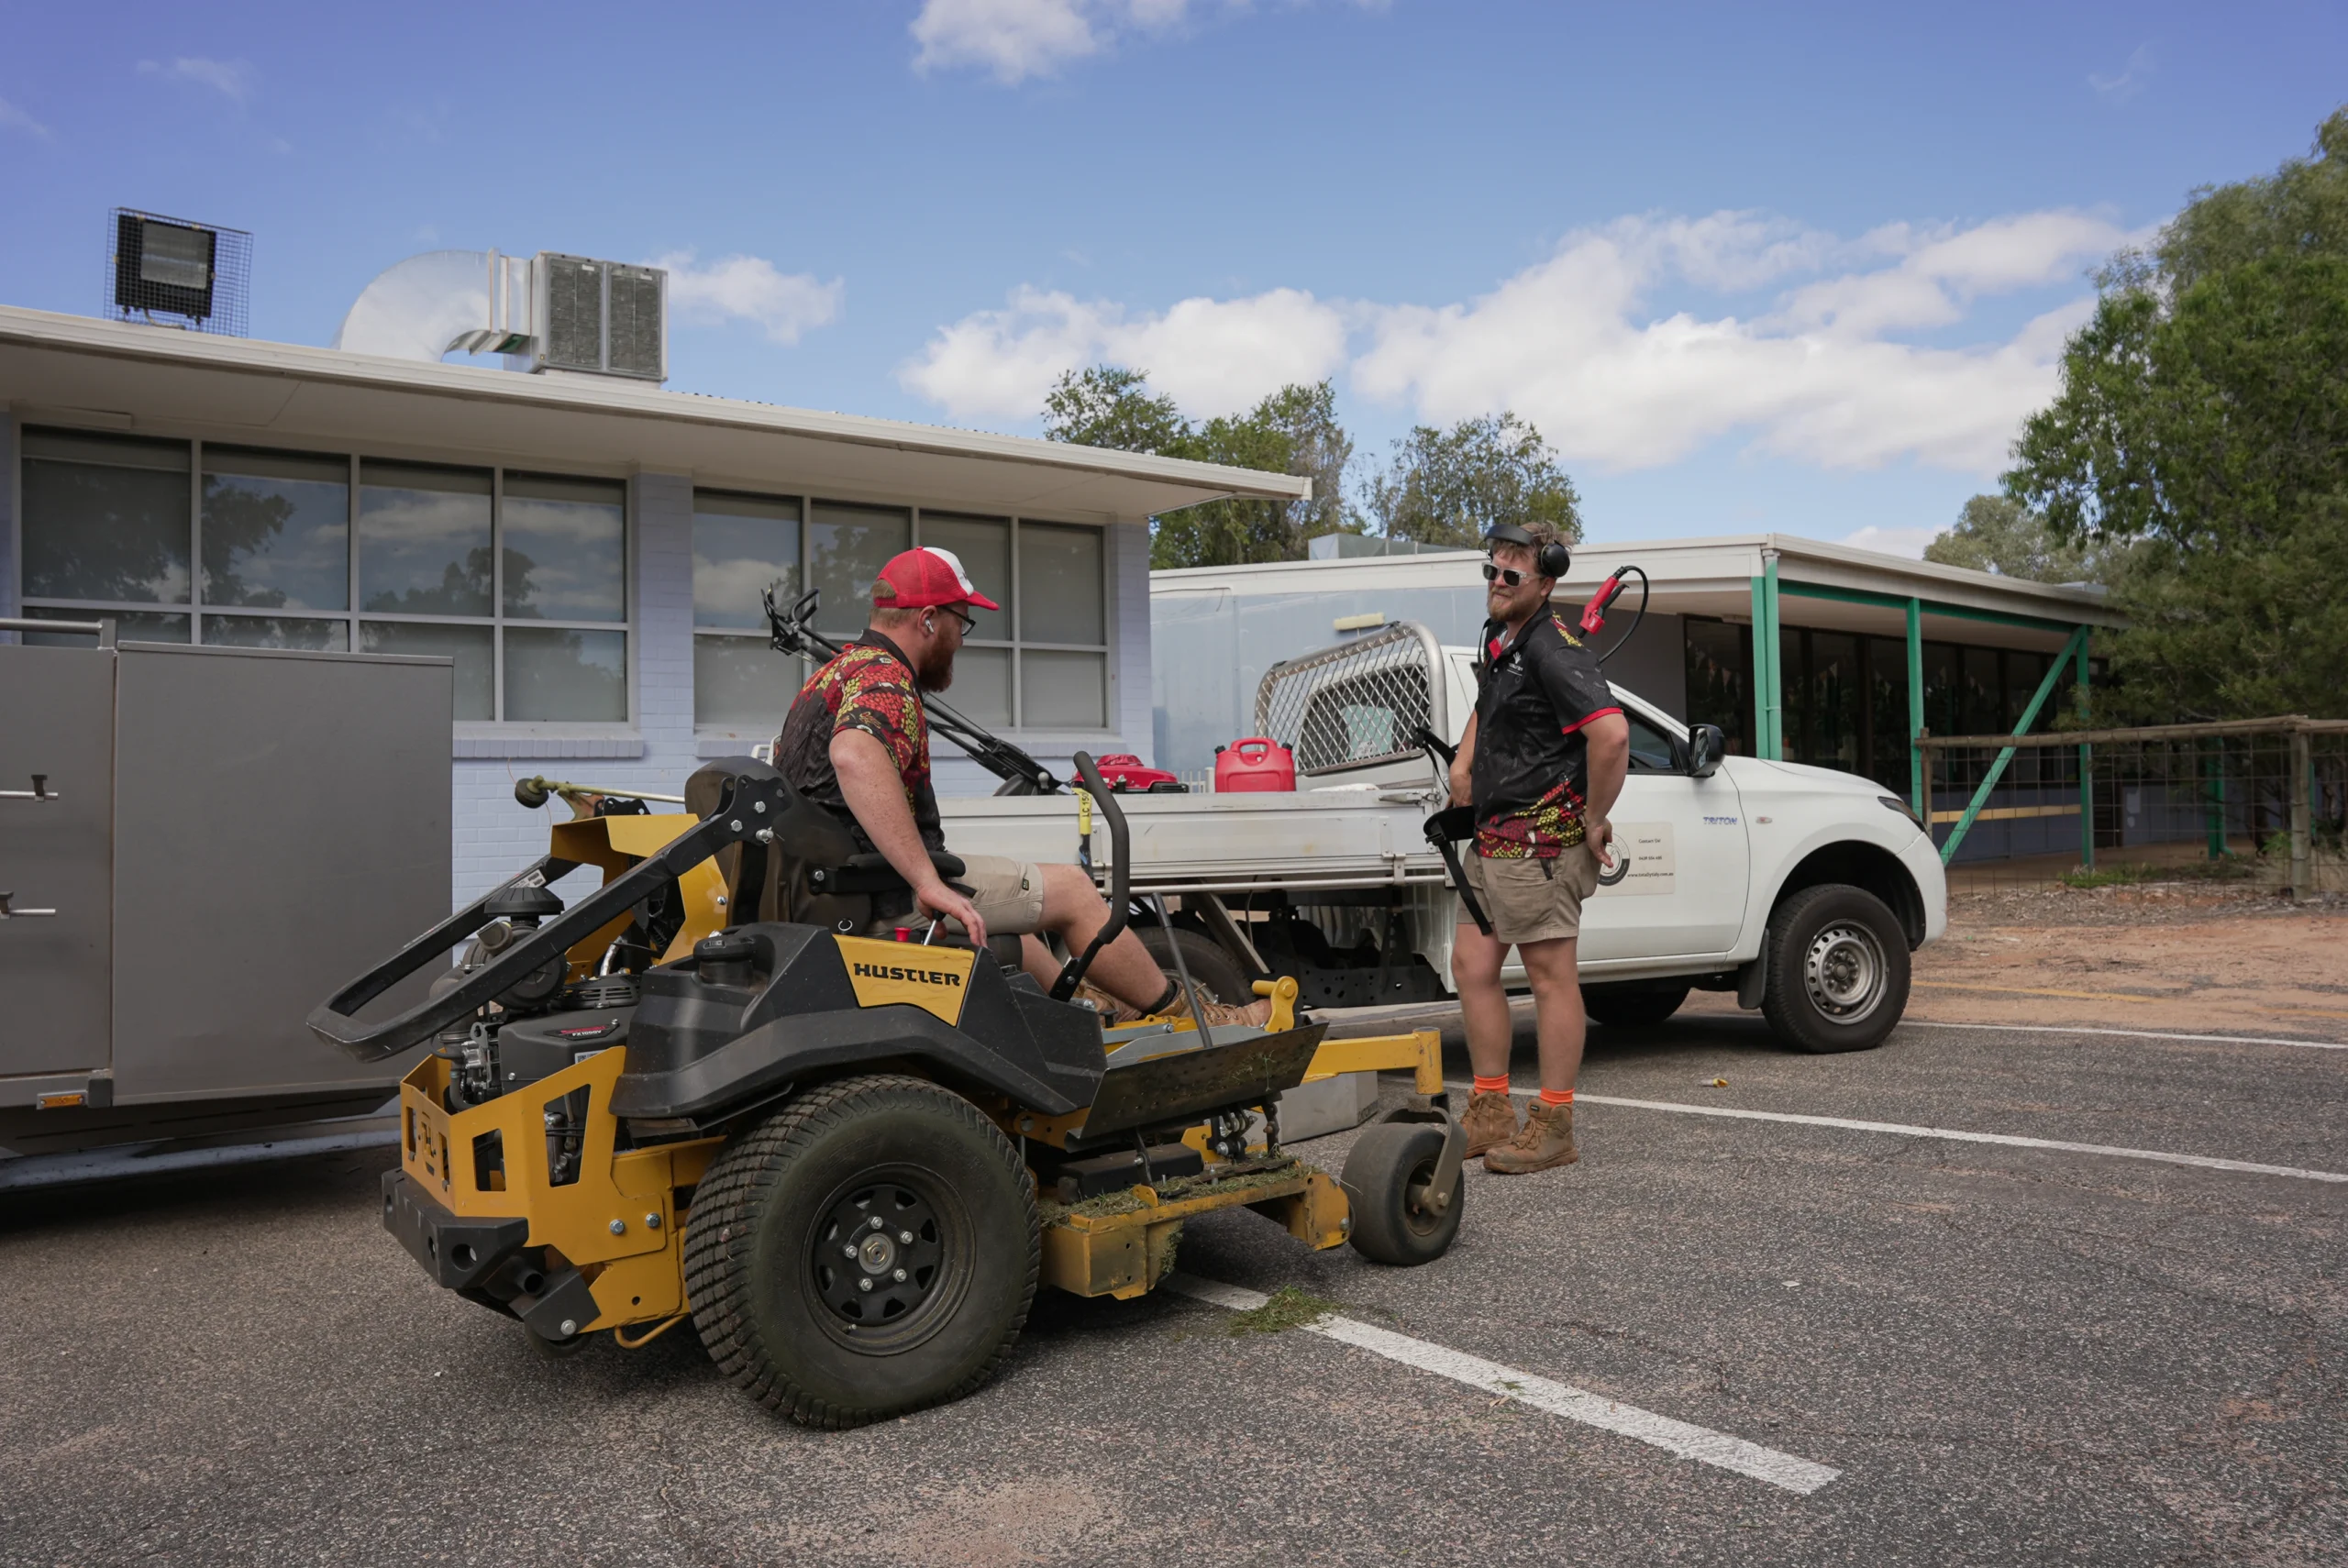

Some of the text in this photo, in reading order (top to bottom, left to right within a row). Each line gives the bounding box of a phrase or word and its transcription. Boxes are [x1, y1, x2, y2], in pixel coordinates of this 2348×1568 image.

[1082, 808, 1090, 817] LC
[1703, 816, 1738, 825] TRITON
[853, 963, 960, 987] HUSTLER
